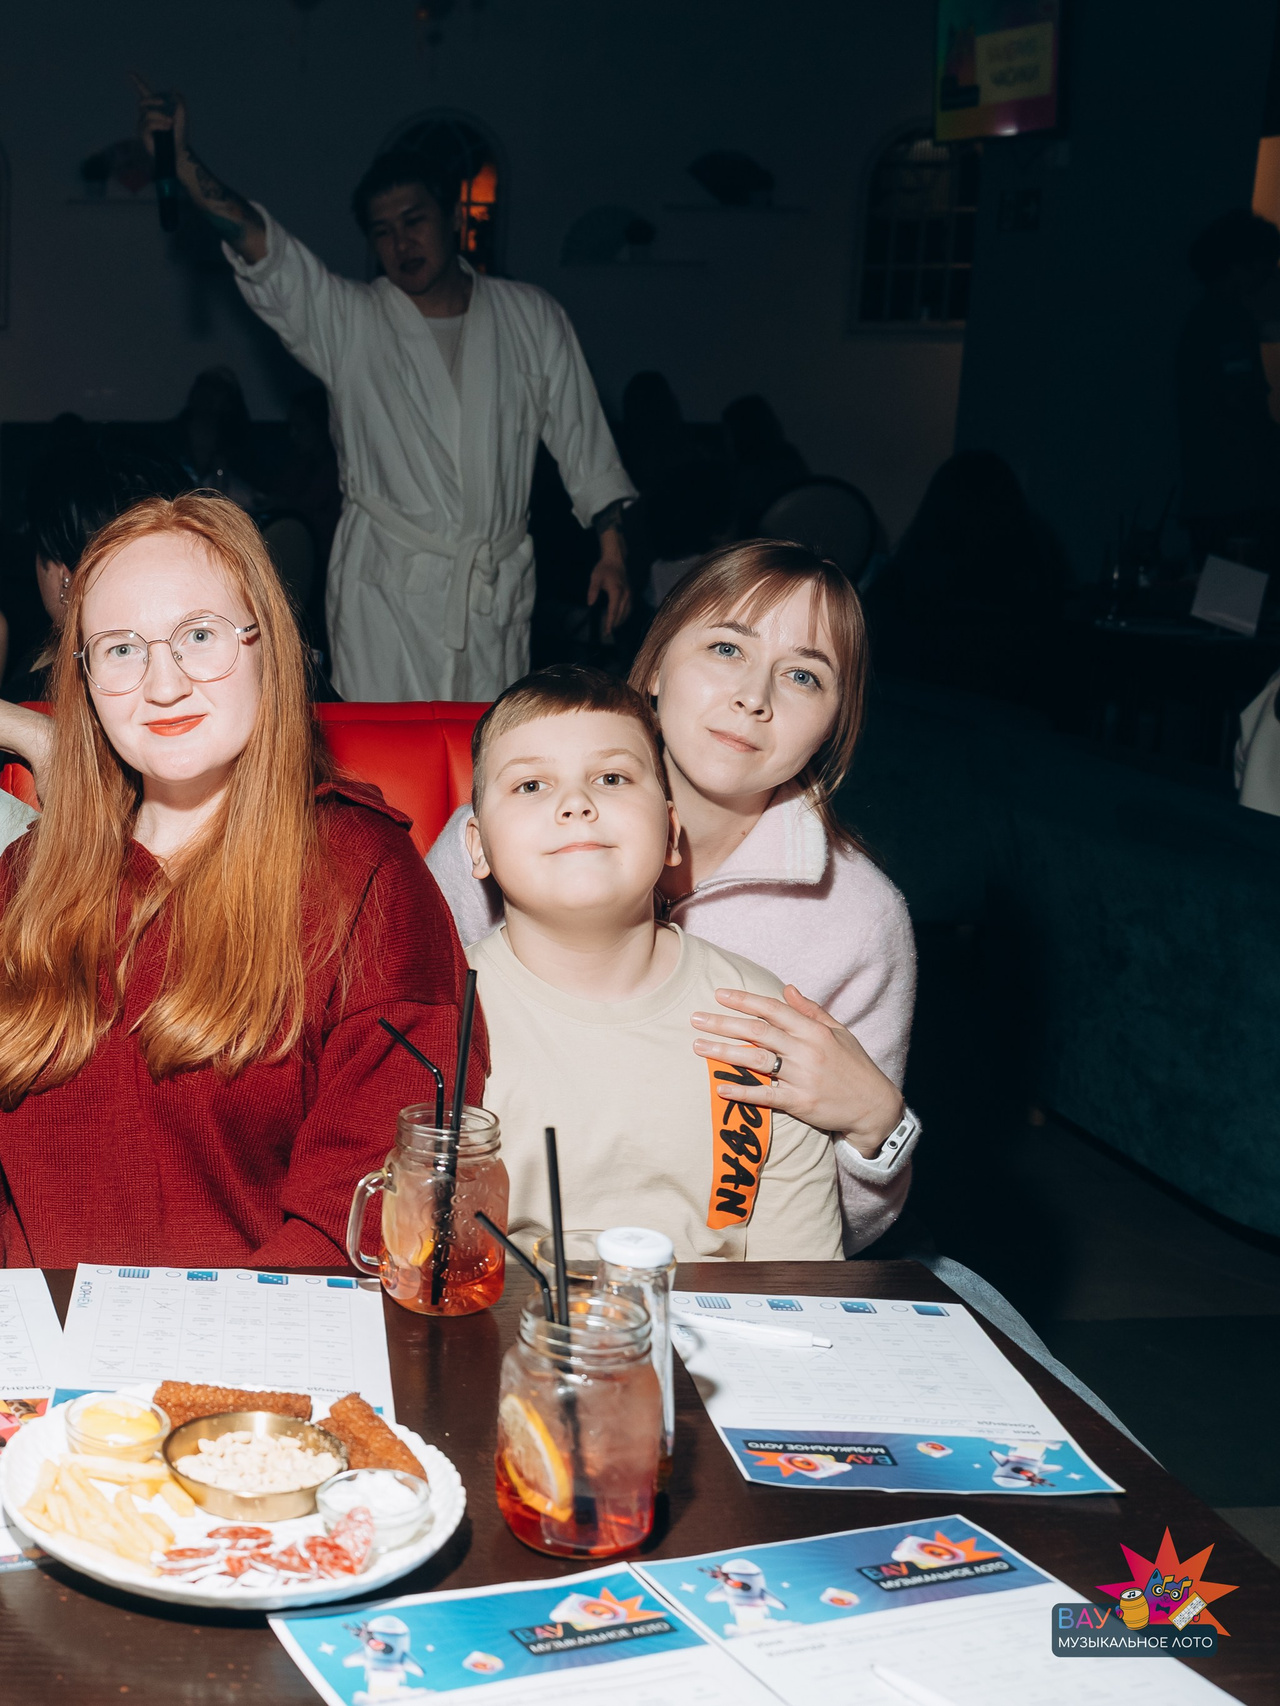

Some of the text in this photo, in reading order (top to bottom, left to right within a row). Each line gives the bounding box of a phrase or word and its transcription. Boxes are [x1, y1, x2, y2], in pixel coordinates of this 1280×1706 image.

[747, 1441, 886, 1455] МУЗЫКАЛЬНОЕ ЛОТО
[846, 1454, 892, 1466] ВАУ
[867, 1561, 909, 1581] ВАУ
[879, 1560, 1011, 1591] МУЗЫКАЛЬНОЕ ЛОТО
[514, 1622, 564, 1644] ВАУ
[527, 1620, 670, 1654] МУЗЫКАЛЬНОЕ ЛОТО
